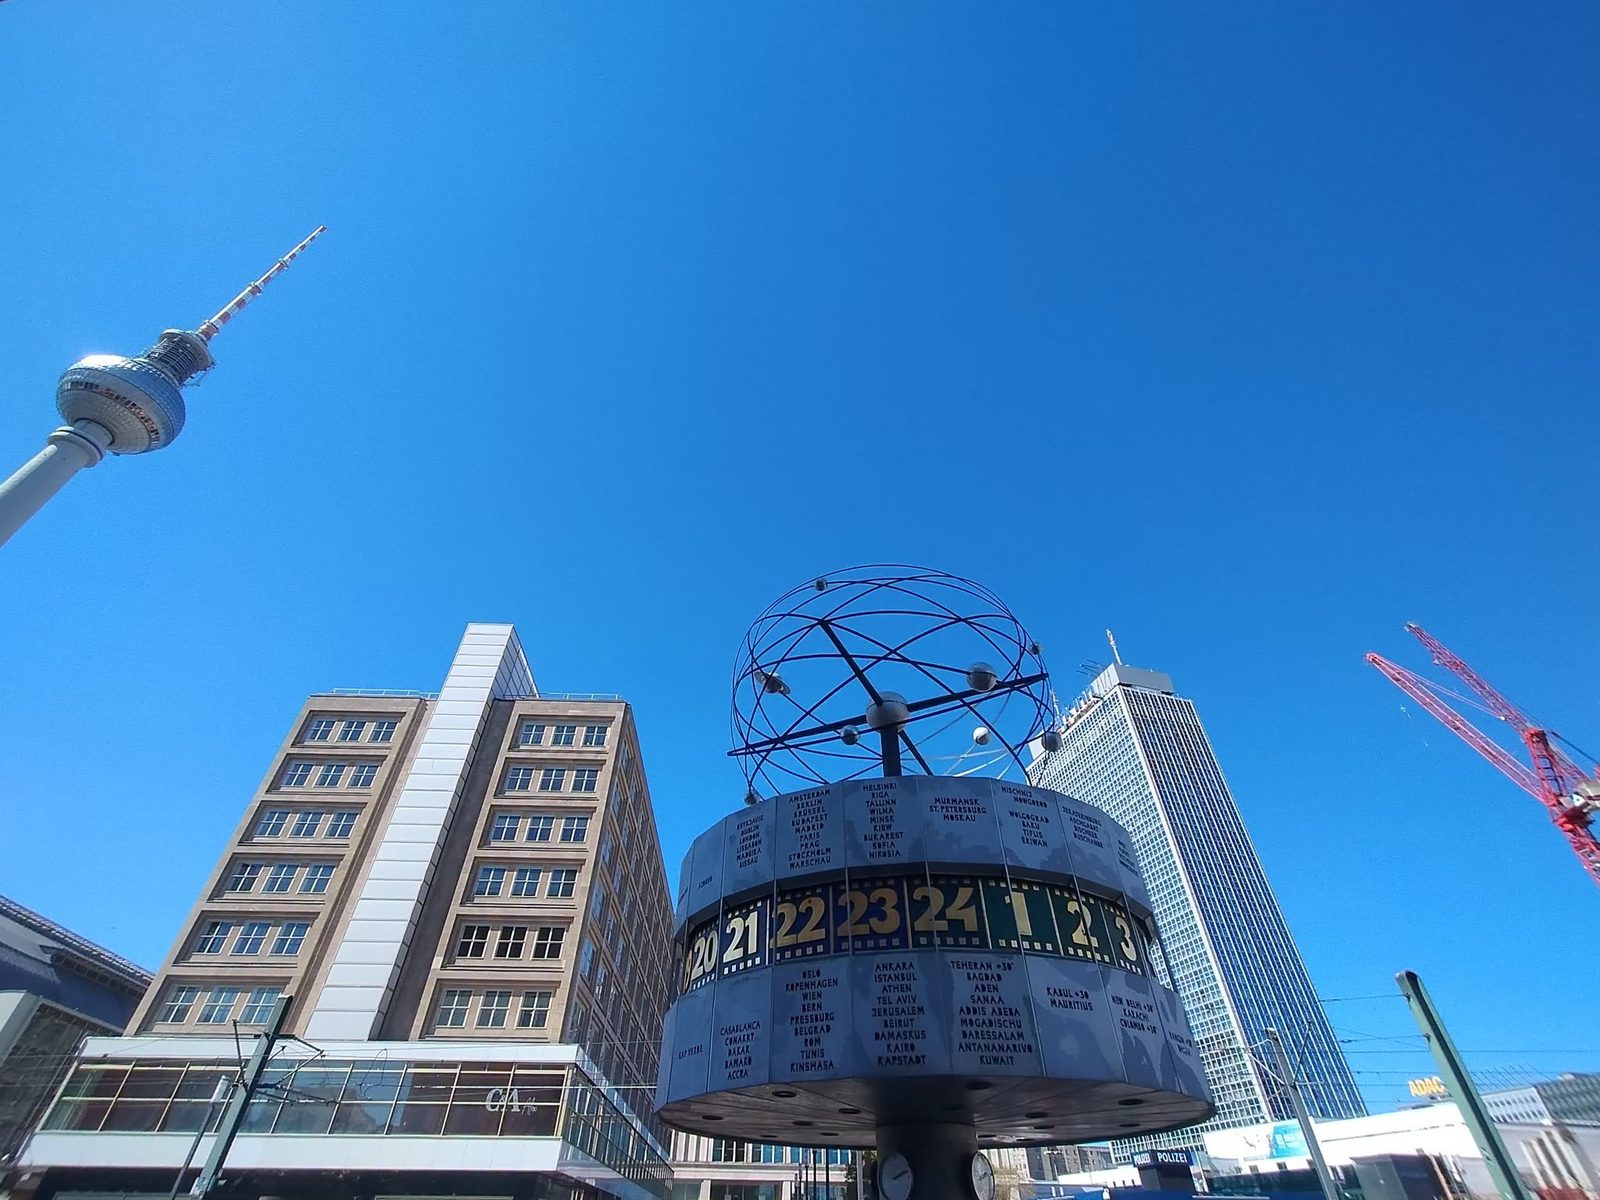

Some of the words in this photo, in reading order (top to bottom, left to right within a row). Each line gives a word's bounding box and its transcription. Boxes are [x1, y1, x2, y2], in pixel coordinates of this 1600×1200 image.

[863, 783, 897, 792] HELSINKI
[789, 789, 830, 804] AMSTERDAM
[934, 797, 980, 805] MURMANSK
[797, 799, 822, 810] BERLIN
[866, 799, 896, 807] TALLINN
[870, 807, 894, 815] WILNA
[792, 814, 828, 826] BUDAPEST
[870, 815, 894, 824] MINSK
[795, 823, 824, 834] MADRID
[1022, 821, 1040, 830] BAKU
[740, 832, 759, 844] LONDON
[800, 832, 820, 842] PARIS
[864, 832, 904, 841] BUKAREST
[737, 839, 762, 854] LISSABON
[800, 840, 820, 850] PRAG
[872, 841, 896, 850] SOFIA
[788, 847, 831, 861] STOCKHOLM
[869, 850, 901, 859] NIKOSIA
[789, 856, 831, 870] WARSCHAU
[837, 888, 900, 937] 23
[912, 886, 978, 932] 24
[1004, 892, 1032, 936] 1
[770, 897, 826, 948] 22
[1067, 901, 1099, 948] 2
[723, 910, 758, 963] 21
[1116, 916, 1137, 961] 3
[691, 930, 718, 980] 20
[875, 962, 915, 972] ANKARA
[951, 960, 992, 970] TEHERAN
[803, 970, 820, 979] OSLO
[874, 973, 917, 983] ISTANBUL
[967, 972, 1002, 982] BAGDAD
[786, 978, 838, 992] KOPENHAGEN
[882, 984, 912, 993] ATHEN
[974, 984, 999, 992] ADEN
[802, 991, 822, 1000] WIEN
[1046, 987, 1073, 998] KABUL
[877, 996, 892, 1005] TEL
[896, 995, 917, 1004] AVIV
[970, 995, 1005, 1004] SANAA
[1050, 999, 1093, 1011] MAURITIUS
[802, 1002, 822, 1012] BERN
[872, 1006, 925, 1017] JERUSALEM
[959, 1007, 986, 1016] ADDIS
[991, 1008, 1020, 1016] ABEBA
[790, 1012, 835, 1025] PRESSBURG
[884, 1019, 914, 1028] BEIRUT
[960, 1018, 1022, 1028] MOGADISCHU
[721, 1020, 760, 1036] CASABLANCA
[794, 1024, 830, 1036] BELGRAD
[874, 1030, 926, 1041] DAMASKUS
[962, 1031, 1024, 1040] DARESSALAM
[804, 1037, 821, 1047] ROM
[728, 1045, 750, 1057] DAKAR
[887, 1043, 915, 1053] KAIRO
[958, 1043, 1033, 1053] ANTANANARIVO
[801, 1049, 824, 1060] TUNIS
[725, 1056, 752, 1069] BAMAKO
[790, 1060, 834, 1072] KINSHASA
[878, 1055, 926, 1066] KAPSTADT
[980, 1056, 1014, 1065] KUWAIT
[728, 1068, 748, 1080] ACCRA
[1157, 1152, 1188, 1163] POLIZEI
